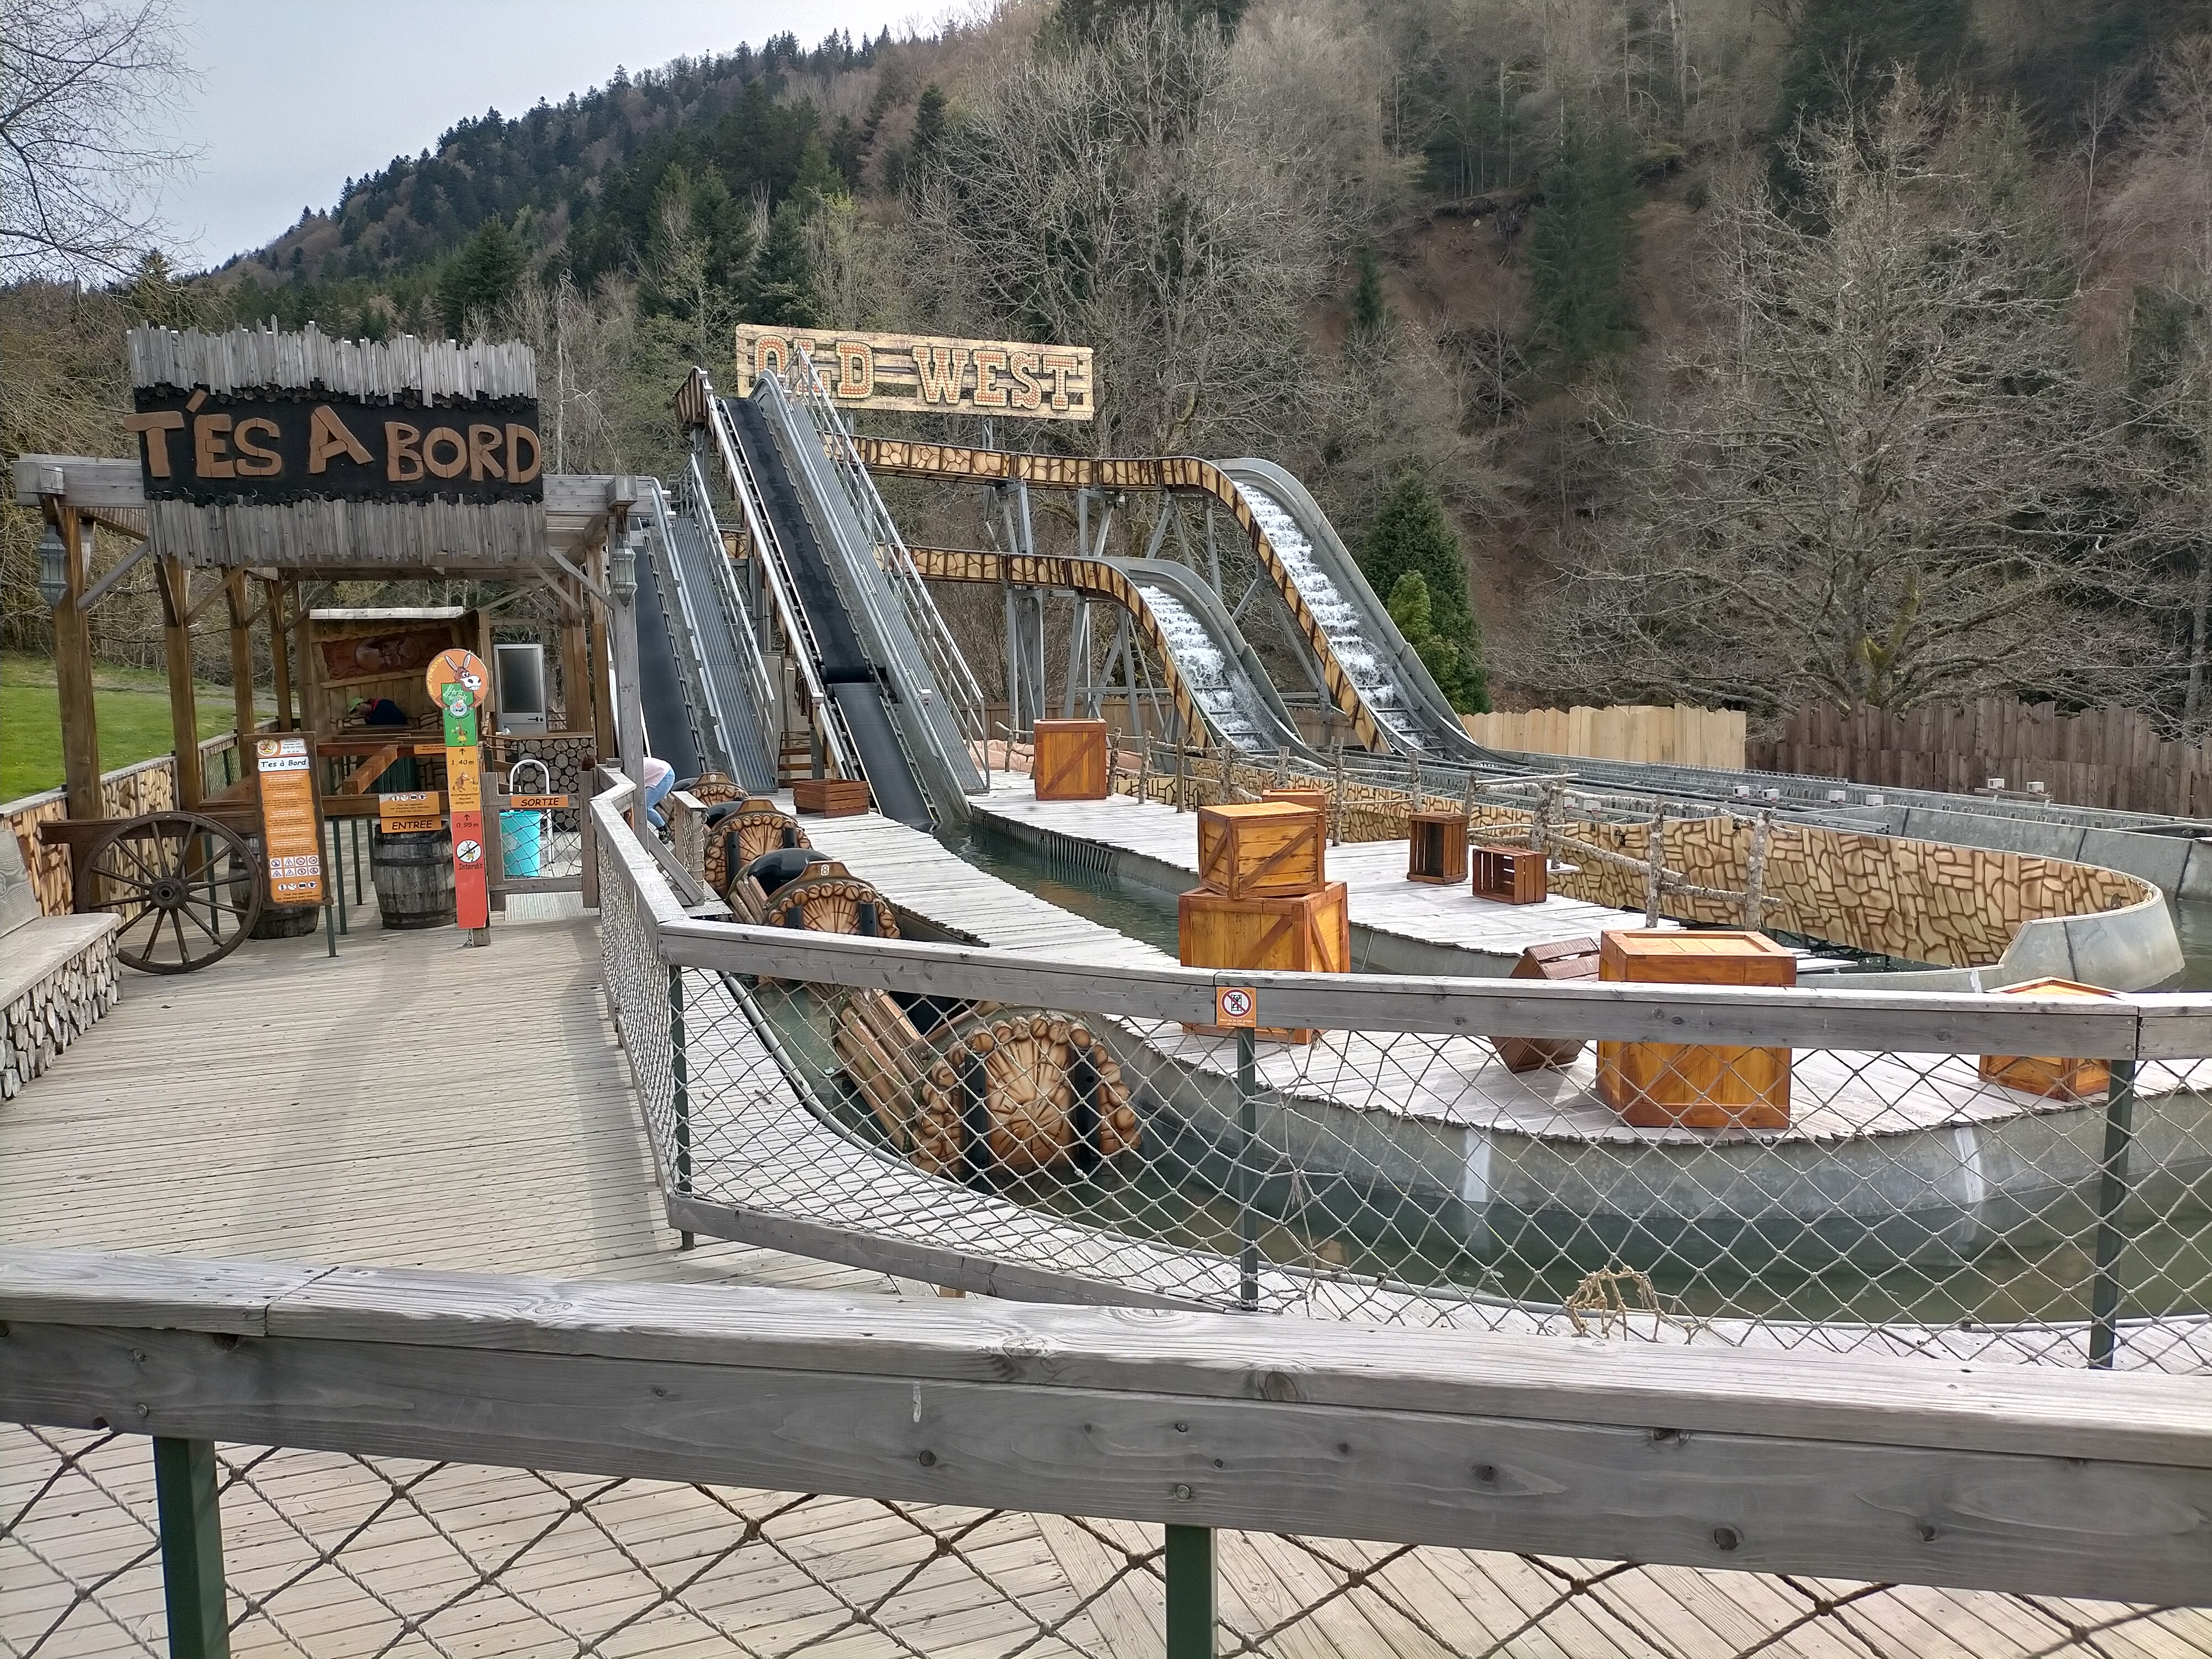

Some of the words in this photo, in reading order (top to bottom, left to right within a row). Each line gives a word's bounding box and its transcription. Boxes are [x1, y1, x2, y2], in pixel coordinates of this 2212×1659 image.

[912, 346, 1079, 410] WEST
[309, 405, 374, 474] A
[385, 421, 541, 483] BORD
[520, 797, 560, 807] SORTIE
[392, 820, 433, 830] ENTREE
[821, 864, 829, 875] 8
